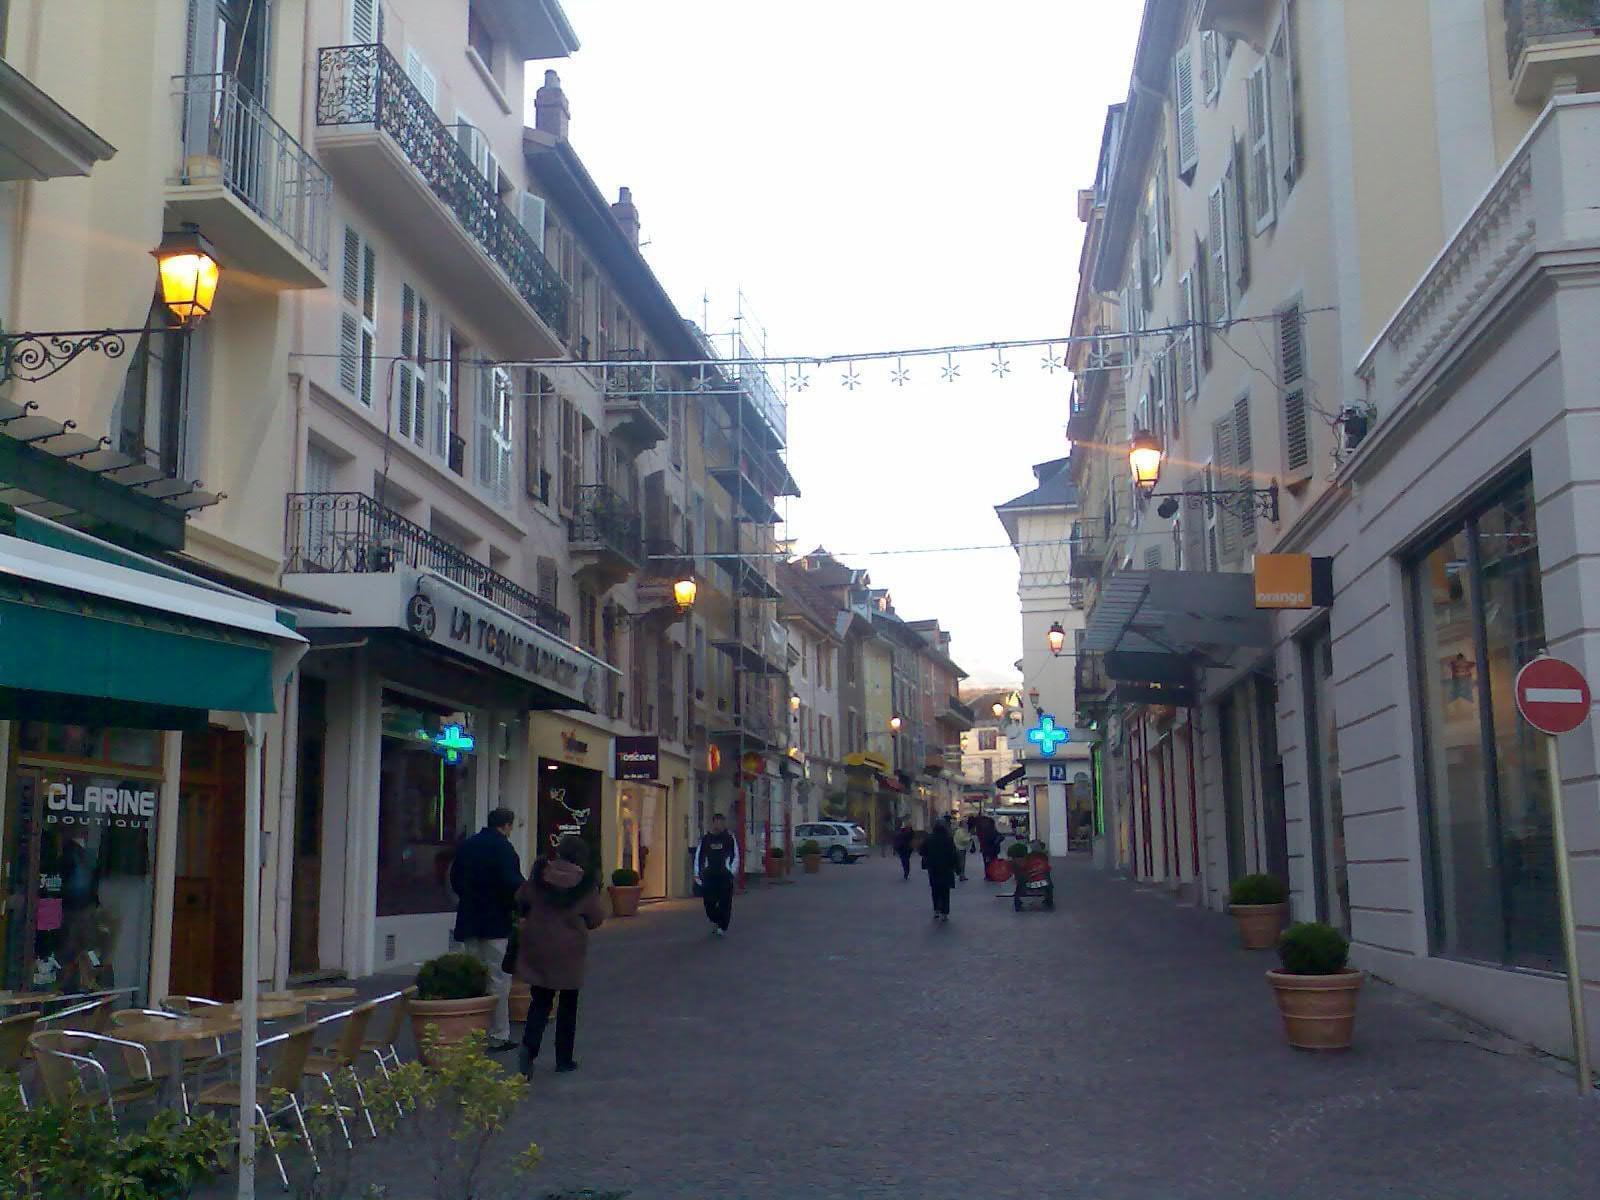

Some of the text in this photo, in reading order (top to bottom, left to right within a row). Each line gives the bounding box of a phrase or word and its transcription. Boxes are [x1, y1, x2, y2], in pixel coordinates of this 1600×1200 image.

[1256, 592, 1304, 607] orange
[451, 606, 471, 644] LA
[47, 782, 155, 817] CLARINE
[47, 814, 153, 829] BOUTIQUE
